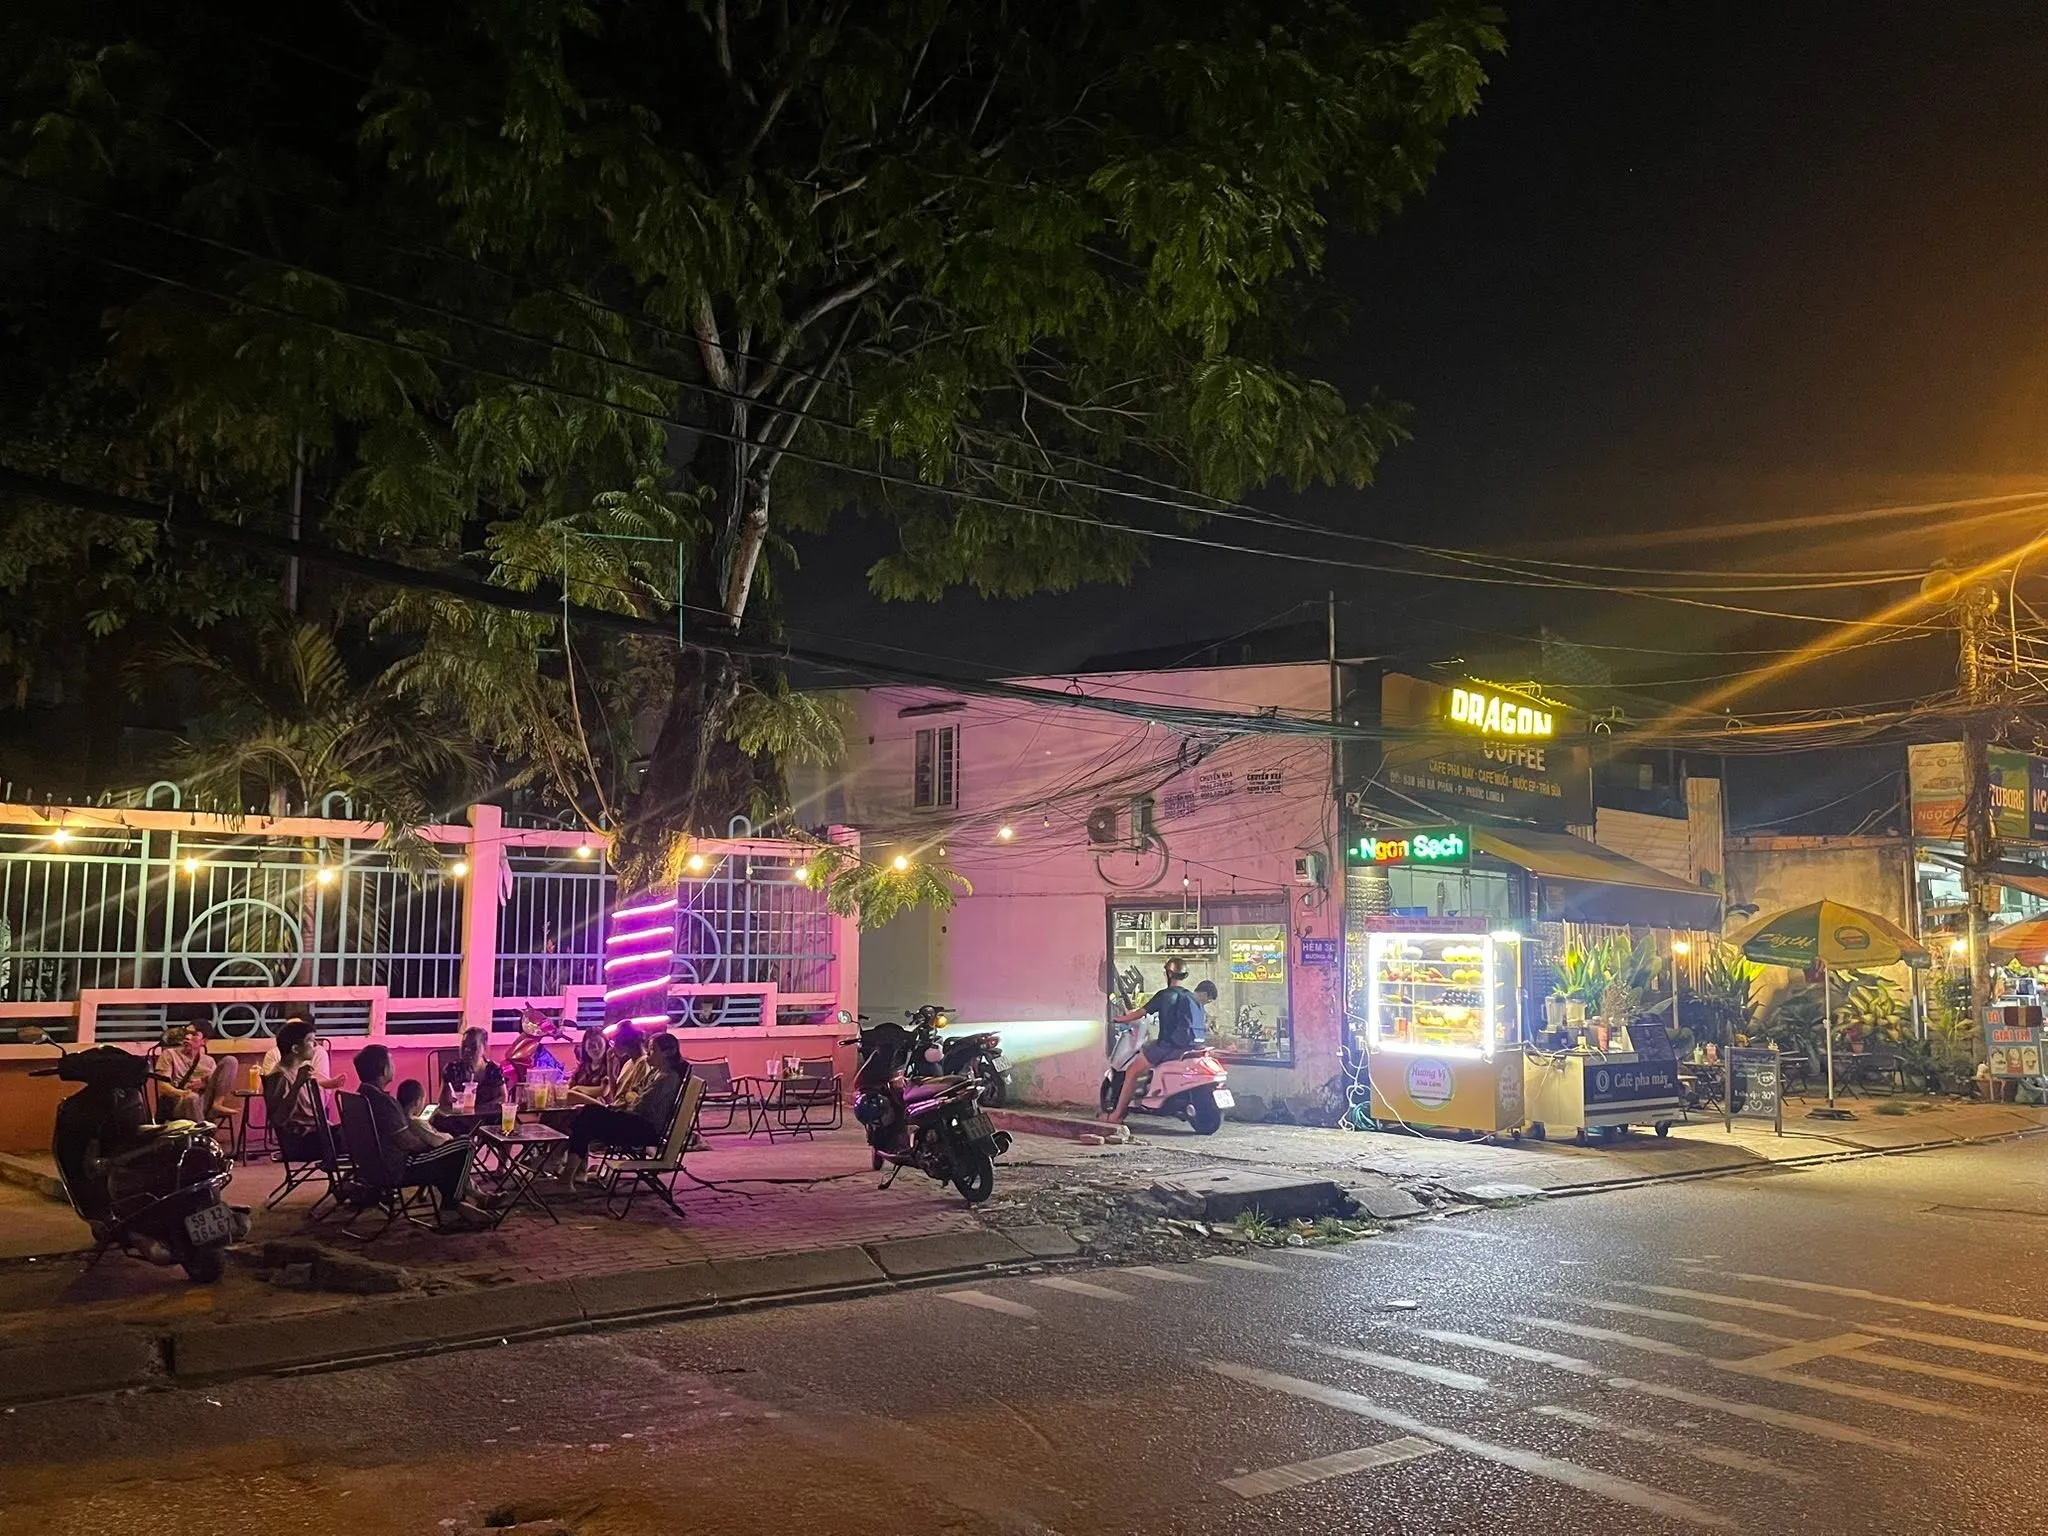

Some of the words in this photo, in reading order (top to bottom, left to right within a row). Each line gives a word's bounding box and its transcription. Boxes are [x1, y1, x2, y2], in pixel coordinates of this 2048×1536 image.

[1451, 688, 1553, 735] DRAGON
[1484, 741, 1546, 772] COFFEE
[1988, 784, 2025, 812] TUBORG
[1360, 838, 1409, 860] Ngon
